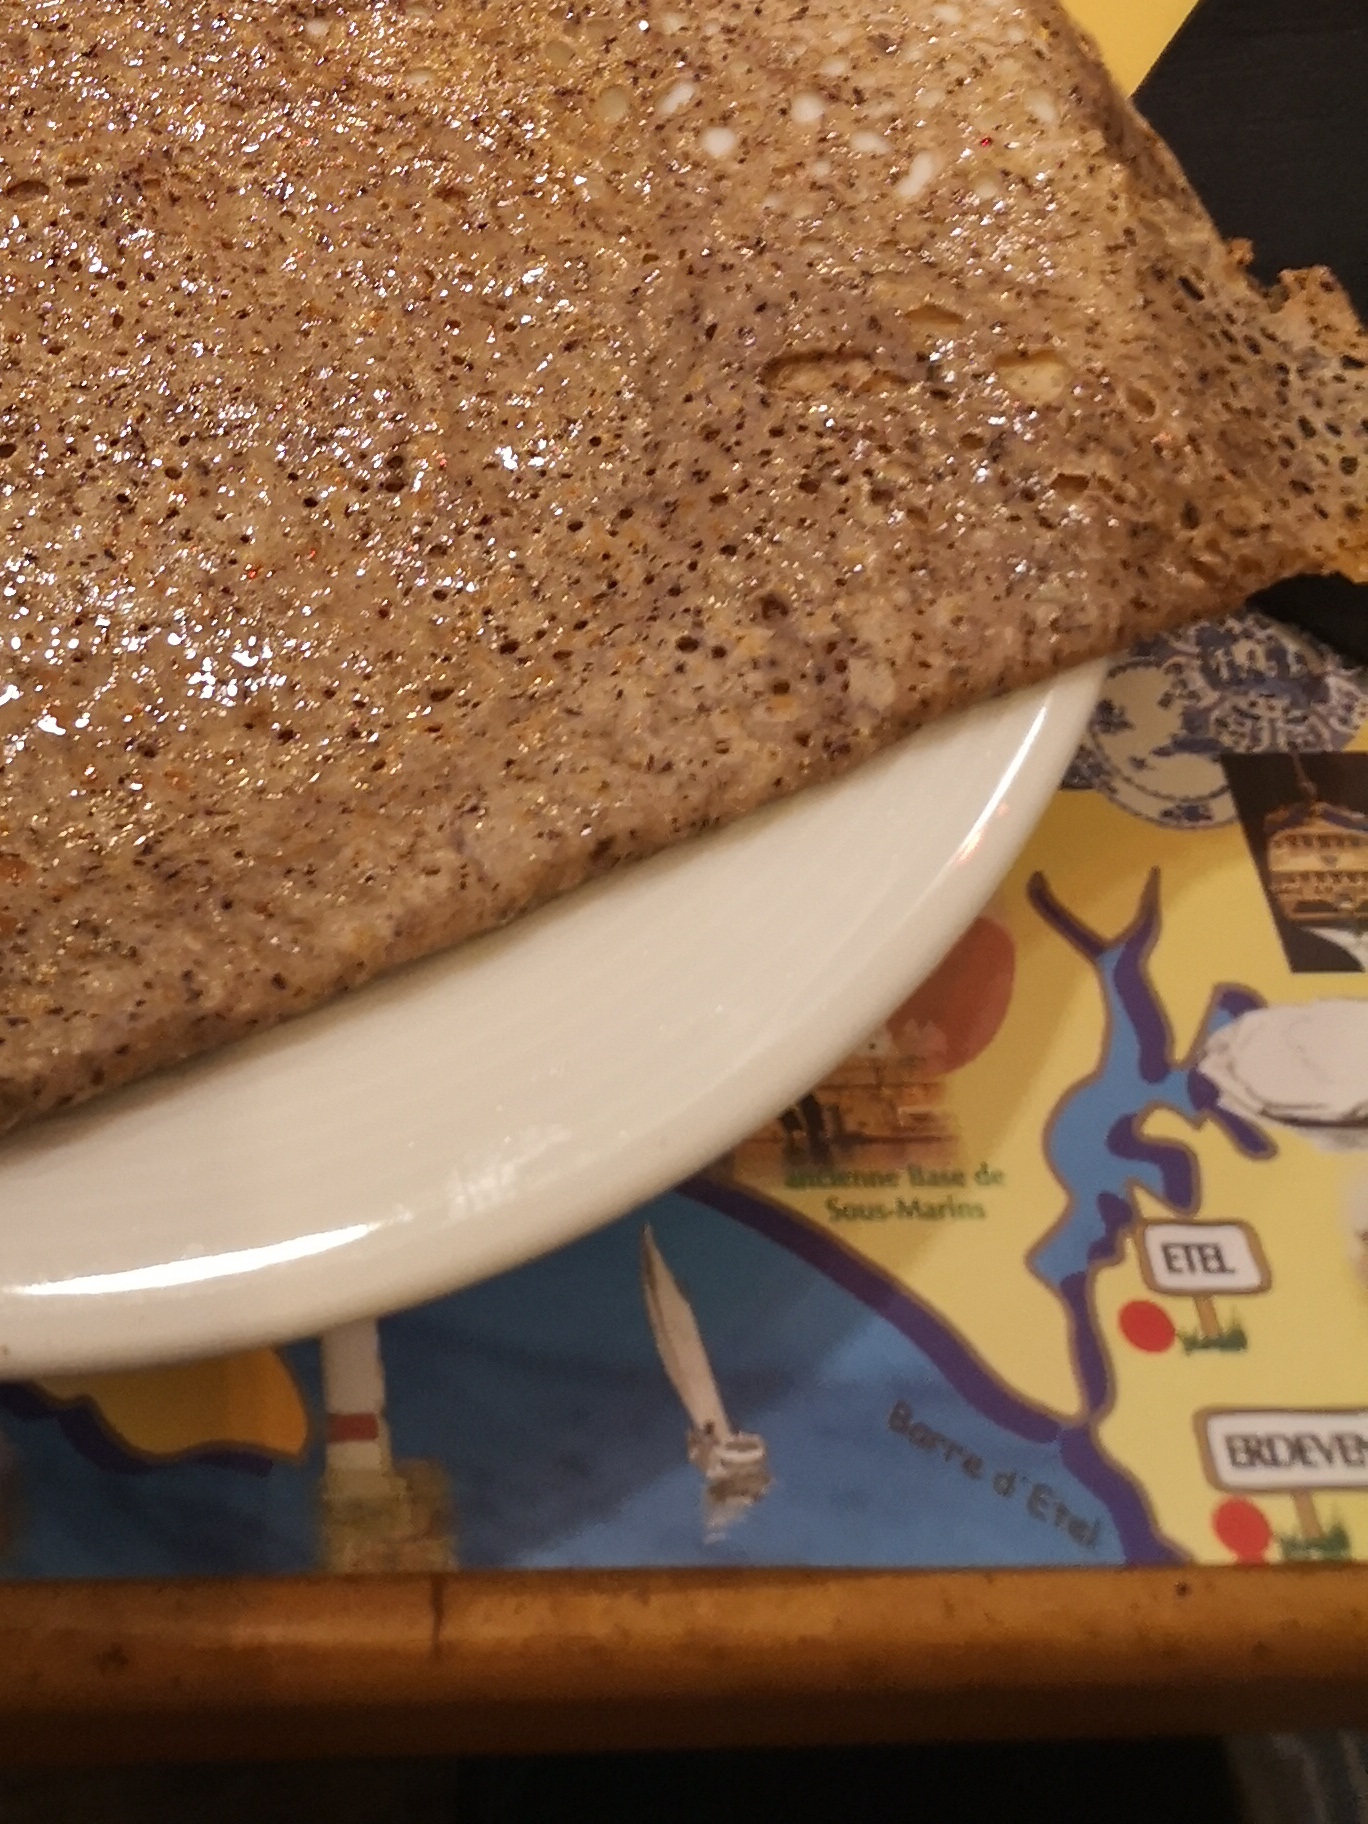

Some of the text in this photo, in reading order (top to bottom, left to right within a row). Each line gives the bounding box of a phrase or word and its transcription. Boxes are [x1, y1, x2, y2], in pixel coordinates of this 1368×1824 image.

[974, 1161, 1005, 1186] de
[825, 1196, 985, 1222] Sous-Marins
[1160, 1242, 1235, 1275] ETEL
